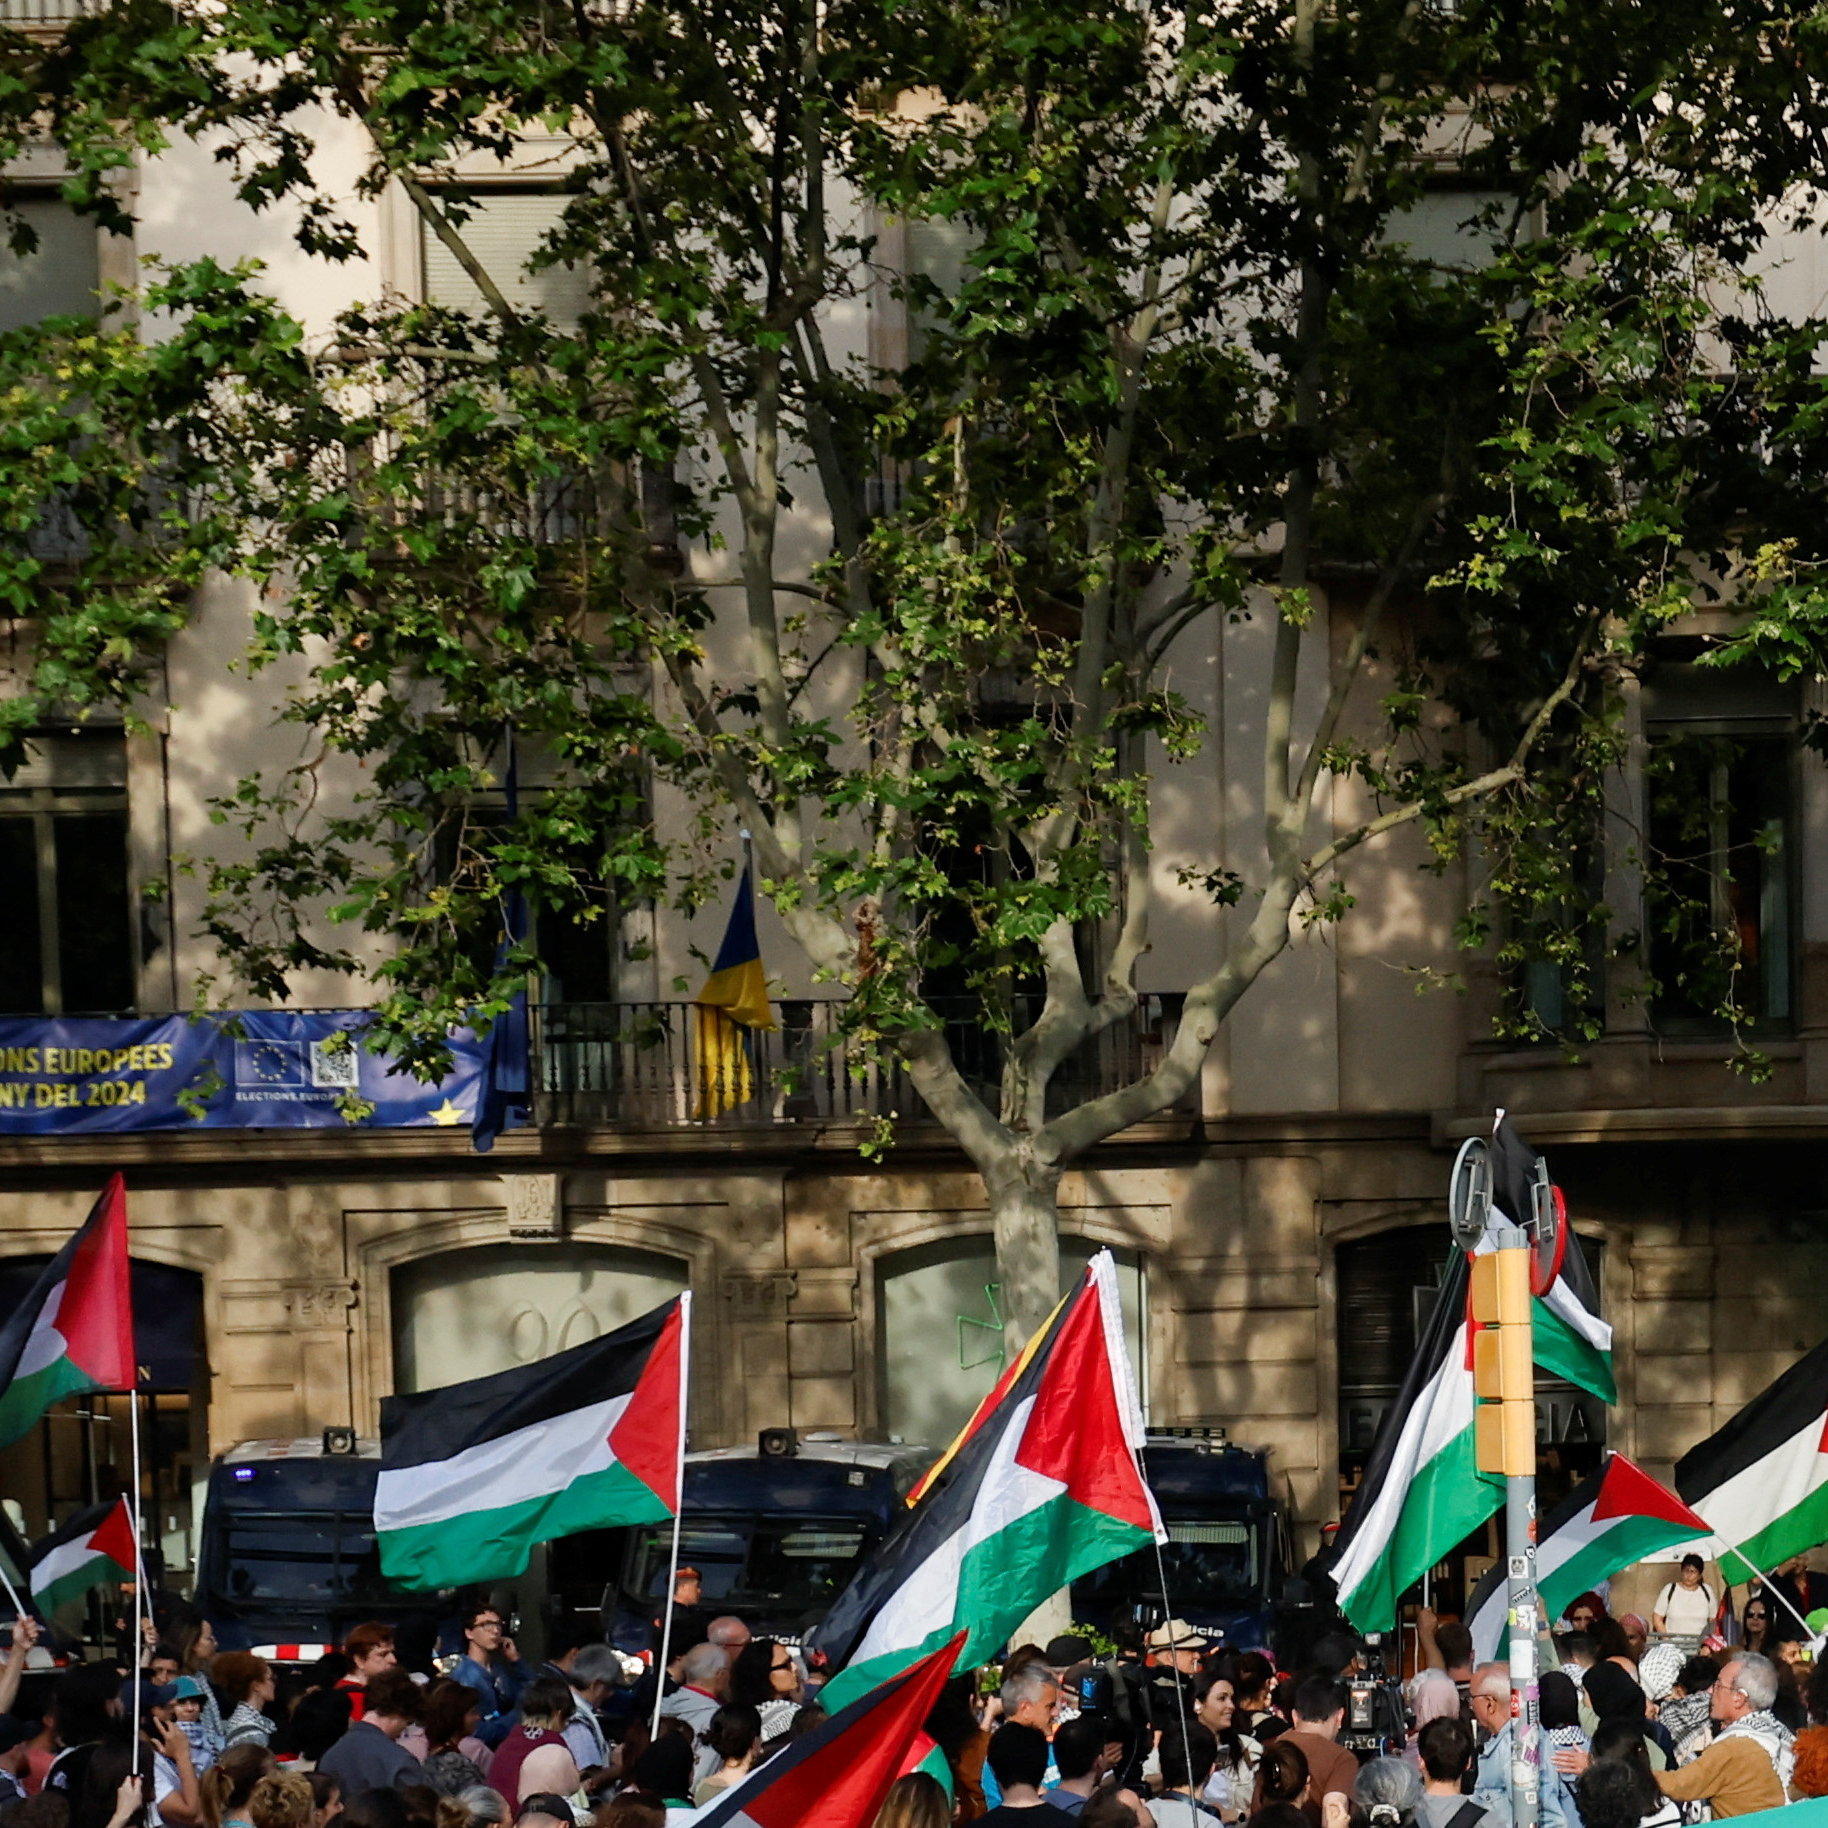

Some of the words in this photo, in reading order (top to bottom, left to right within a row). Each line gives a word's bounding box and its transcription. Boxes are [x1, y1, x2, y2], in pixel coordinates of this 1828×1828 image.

[44, 1043, 173, 1074] EUROPEES
[35, 1083, 81, 1108] DEL
[87, 1080, 146, 1106] 2024
